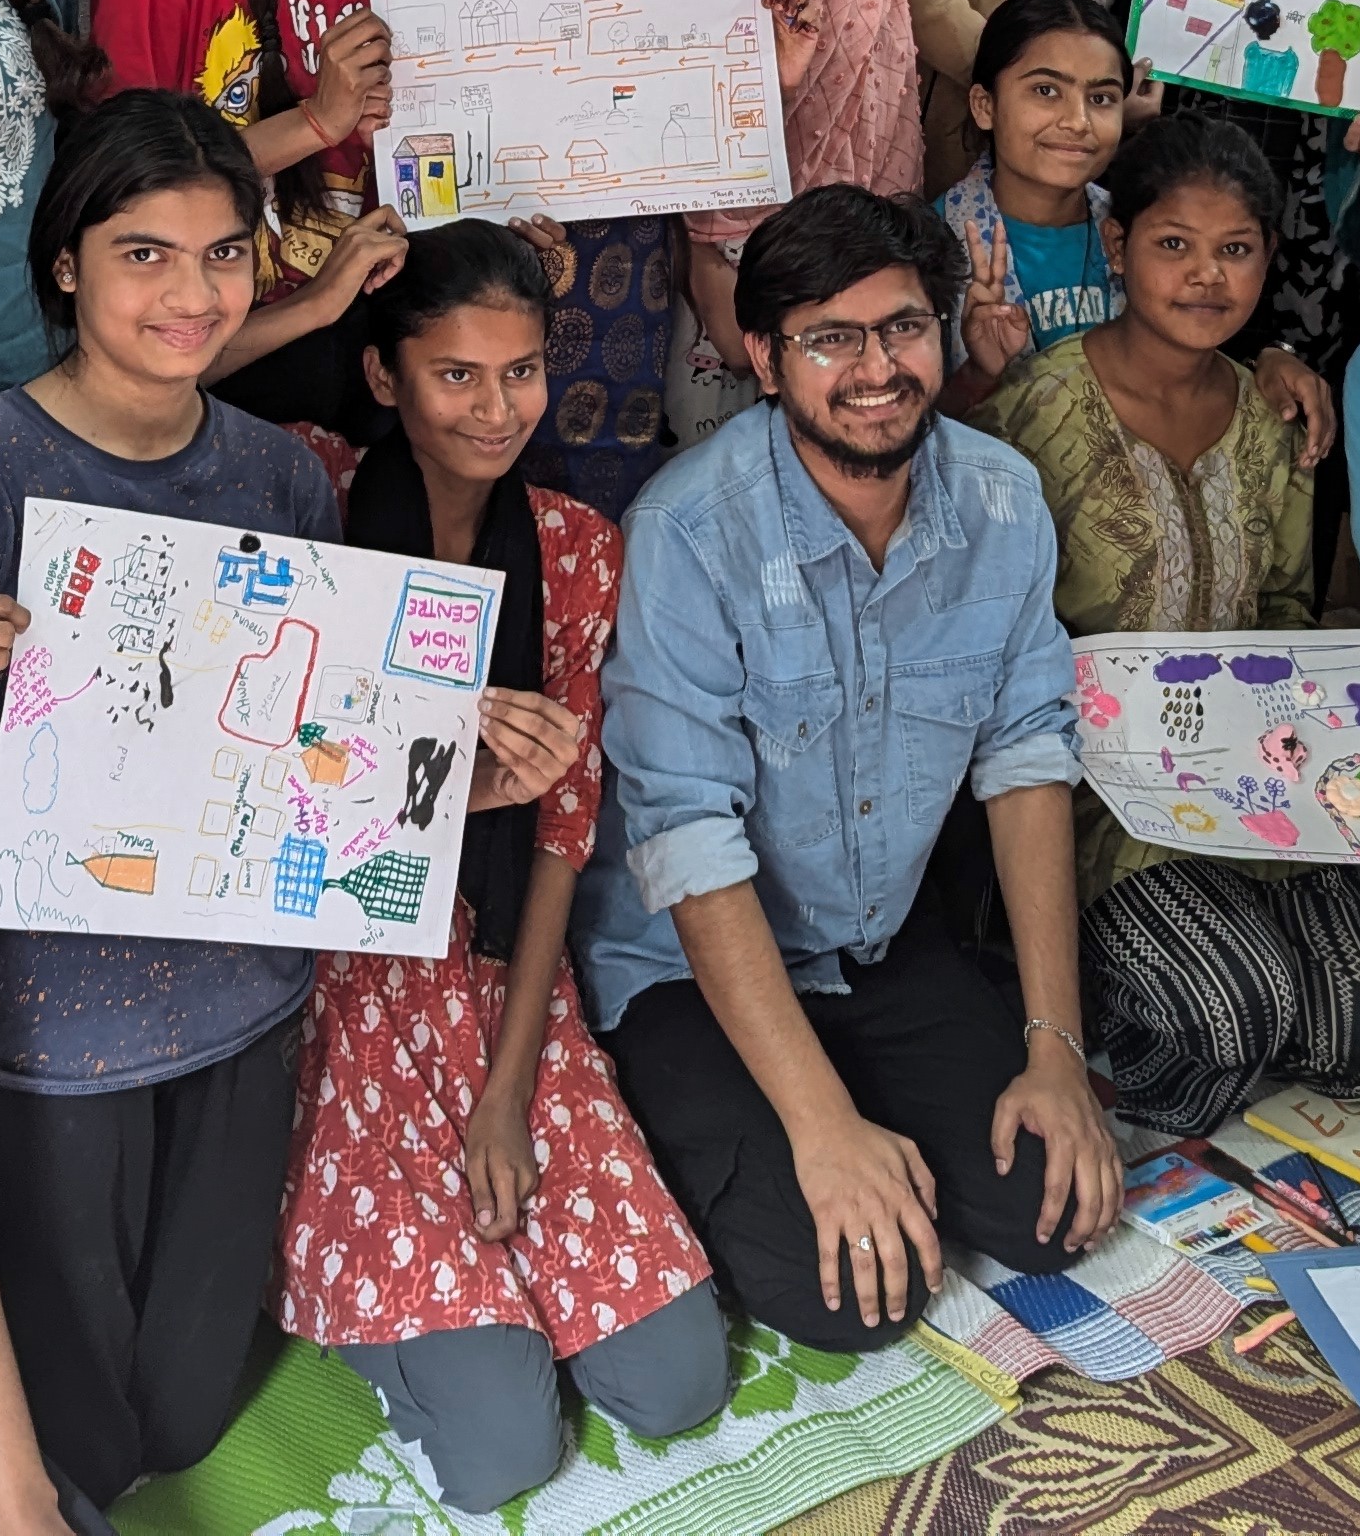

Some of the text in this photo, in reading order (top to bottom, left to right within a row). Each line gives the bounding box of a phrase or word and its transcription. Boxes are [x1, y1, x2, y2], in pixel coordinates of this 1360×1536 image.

[630, 199, 688, 214] PRESENTED
[407, 597, 479, 624] CENTRE
[409, 629, 466, 650] INDIA
[421, 652, 470, 674] PLAN
[108, 745, 129, 783] Road
[357, 837, 382, 859] This
